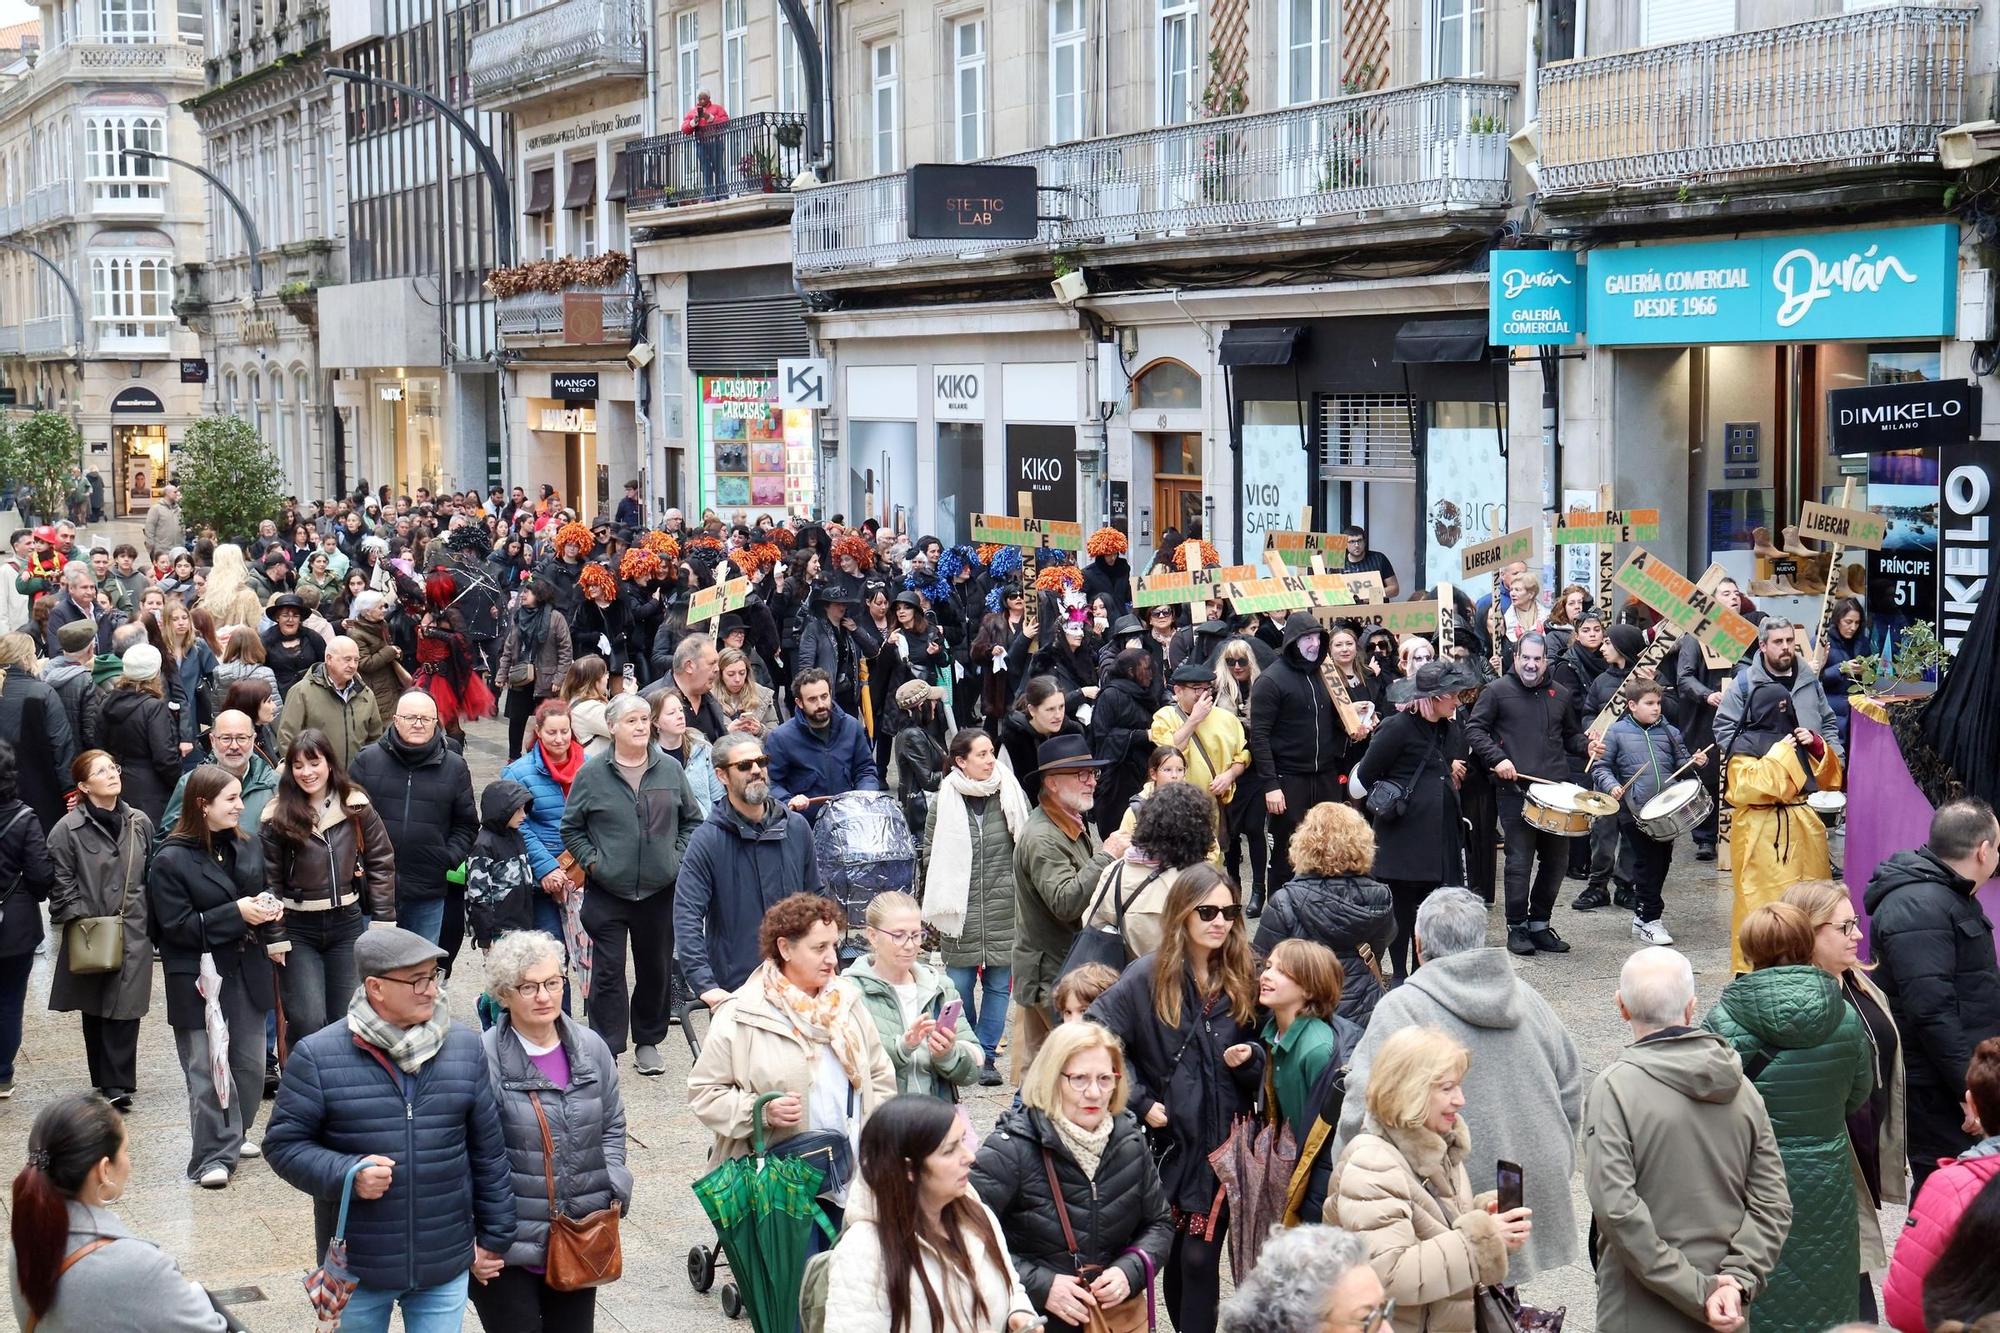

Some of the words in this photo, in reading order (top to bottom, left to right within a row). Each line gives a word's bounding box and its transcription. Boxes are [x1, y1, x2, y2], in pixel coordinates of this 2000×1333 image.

[958, 212, 992, 225] LAB
[1502, 268, 1572, 299] Durán
[1605, 270, 1663, 295] GALERÍA
[1665, 268, 1750, 293] COMERCIAL
[1773, 244, 1918, 327] Durán
[1511, 306, 1562, 322] GALERÍA
[1633, 299, 1678, 319] DESDE
[1681, 296, 1718, 317] 1966
[1502, 321, 1571, 335] COMERCIAL
[555, 379, 596, 388] MANGO
[711, 380, 721, 398] LA
[724, 380, 745, 398] CASA
[747, 380, 759, 398] DE
[937, 374, 979, 399] KIKO
[722, 401, 766, 420] CARCASAS
[1157, 414, 1167, 429] 49
[1881, 422, 1919, 431] MILANO
[1021, 457, 1062, 481] KIKO
[1246, 484, 1280, 507] VIGO
[975, 514, 983, 527] A
[1024, 518, 1041, 532] FAI
[1557, 513, 1565, 528] A
[1606, 510, 1622, 525] FAI
[1807, 512, 1850, 537] LIBERAR
[1042, 534, 1049, 548] E
[1267, 534, 1274, 548] A
[1305, 534, 1318, 549] FAI
[1622, 526, 1629, 542] E
[1465, 546, 1501, 571] LIBERAR
[1880, 555, 1930, 576] PRÍNCIPE
[1776, 565, 1796, 573] NUEVO
[1137, 577, 1147, 591] A
[1192, 569, 1212, 585] FAI
[1229, 582, 1243, 598] A
[1282, 575, 1306, 592] FAI
[1631, 551, 1647, 569] A
[1687, 590, 1715, 616] FAI
[1213, 584, 1221, 599] E
[1309, 591, 1320, 606] E
[1620, 564, 1697, 625] BEMBRIVE
[1694, 618, 1711, 636] E
[1894, 580, 1916, 606] 51
[1388, 613, 1400, 629] A
